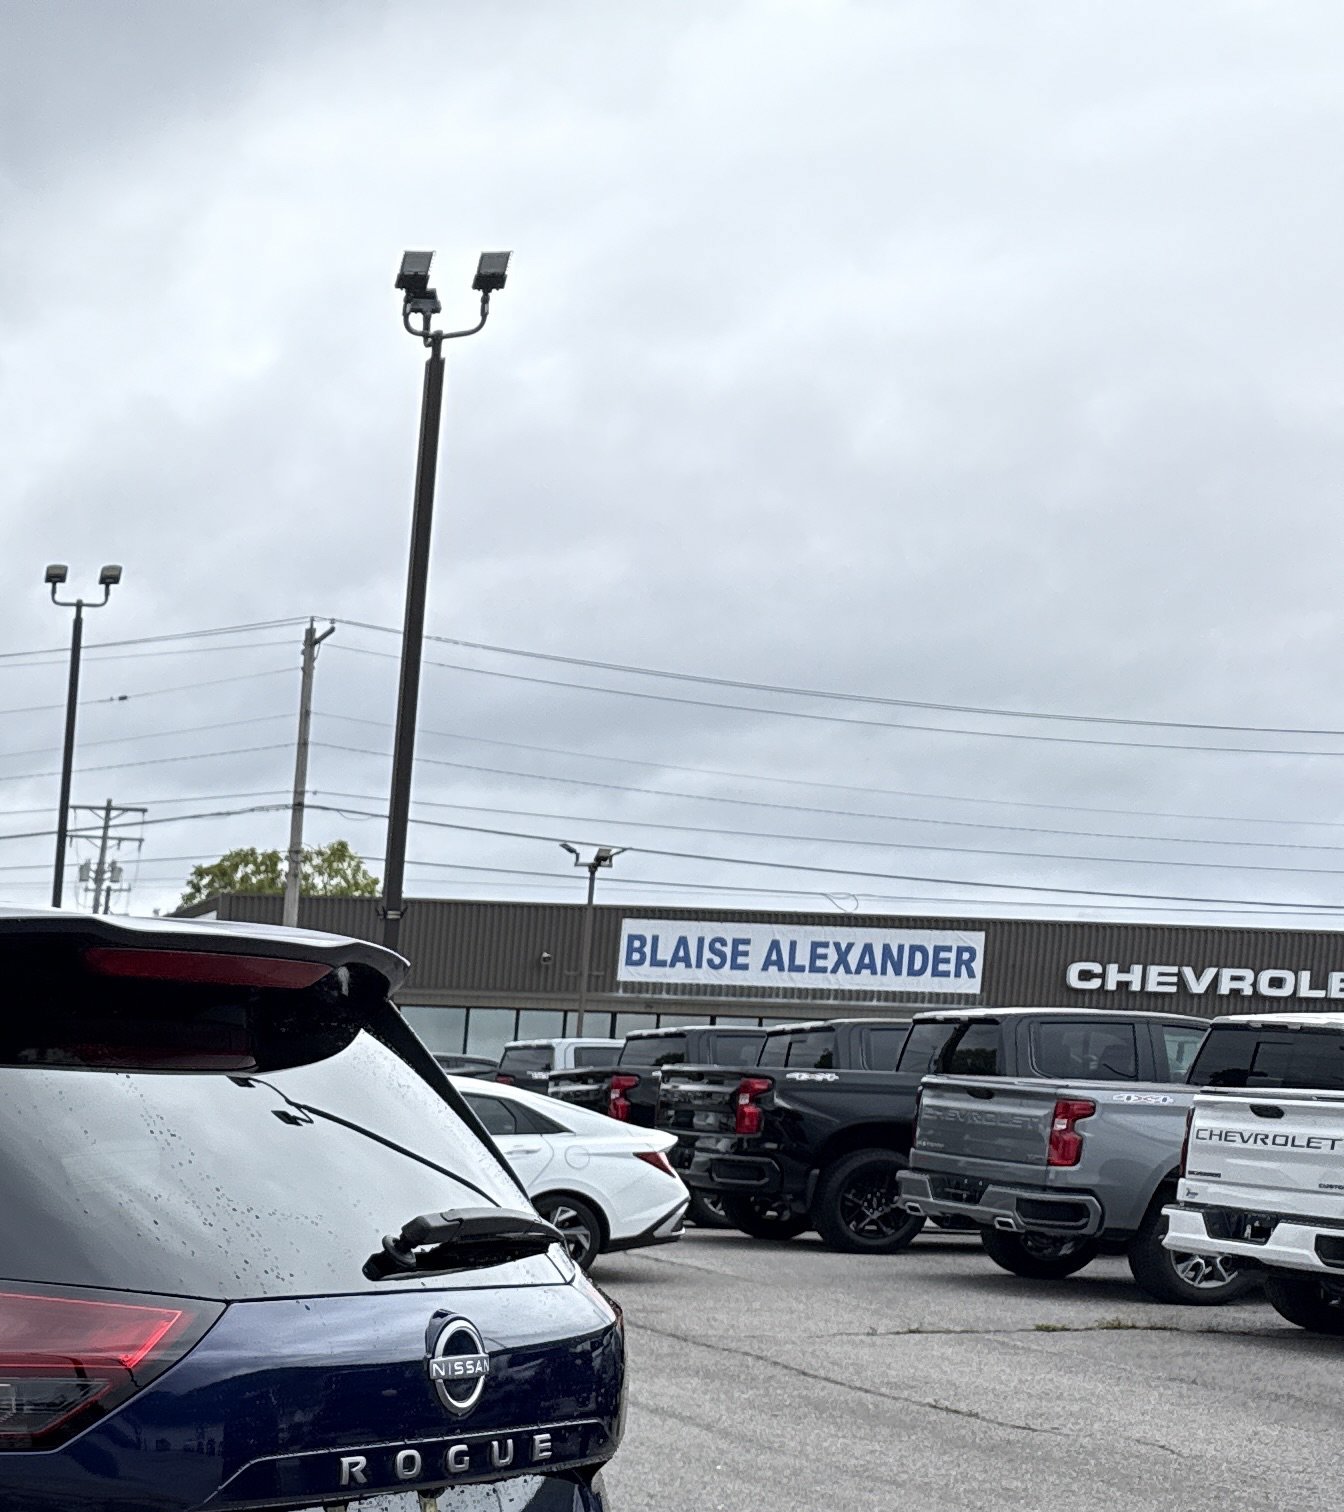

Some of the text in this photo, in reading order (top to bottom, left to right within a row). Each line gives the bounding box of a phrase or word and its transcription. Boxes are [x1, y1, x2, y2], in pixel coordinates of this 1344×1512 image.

[624, 933, 977, 979] BLAISE ALEXANDER
[1195, 1128, 1344, 1151] CHEVROLET
[431, 1356, 490, 1377] NISSAN
[340, 1433, 553, 1486] ROGUE
